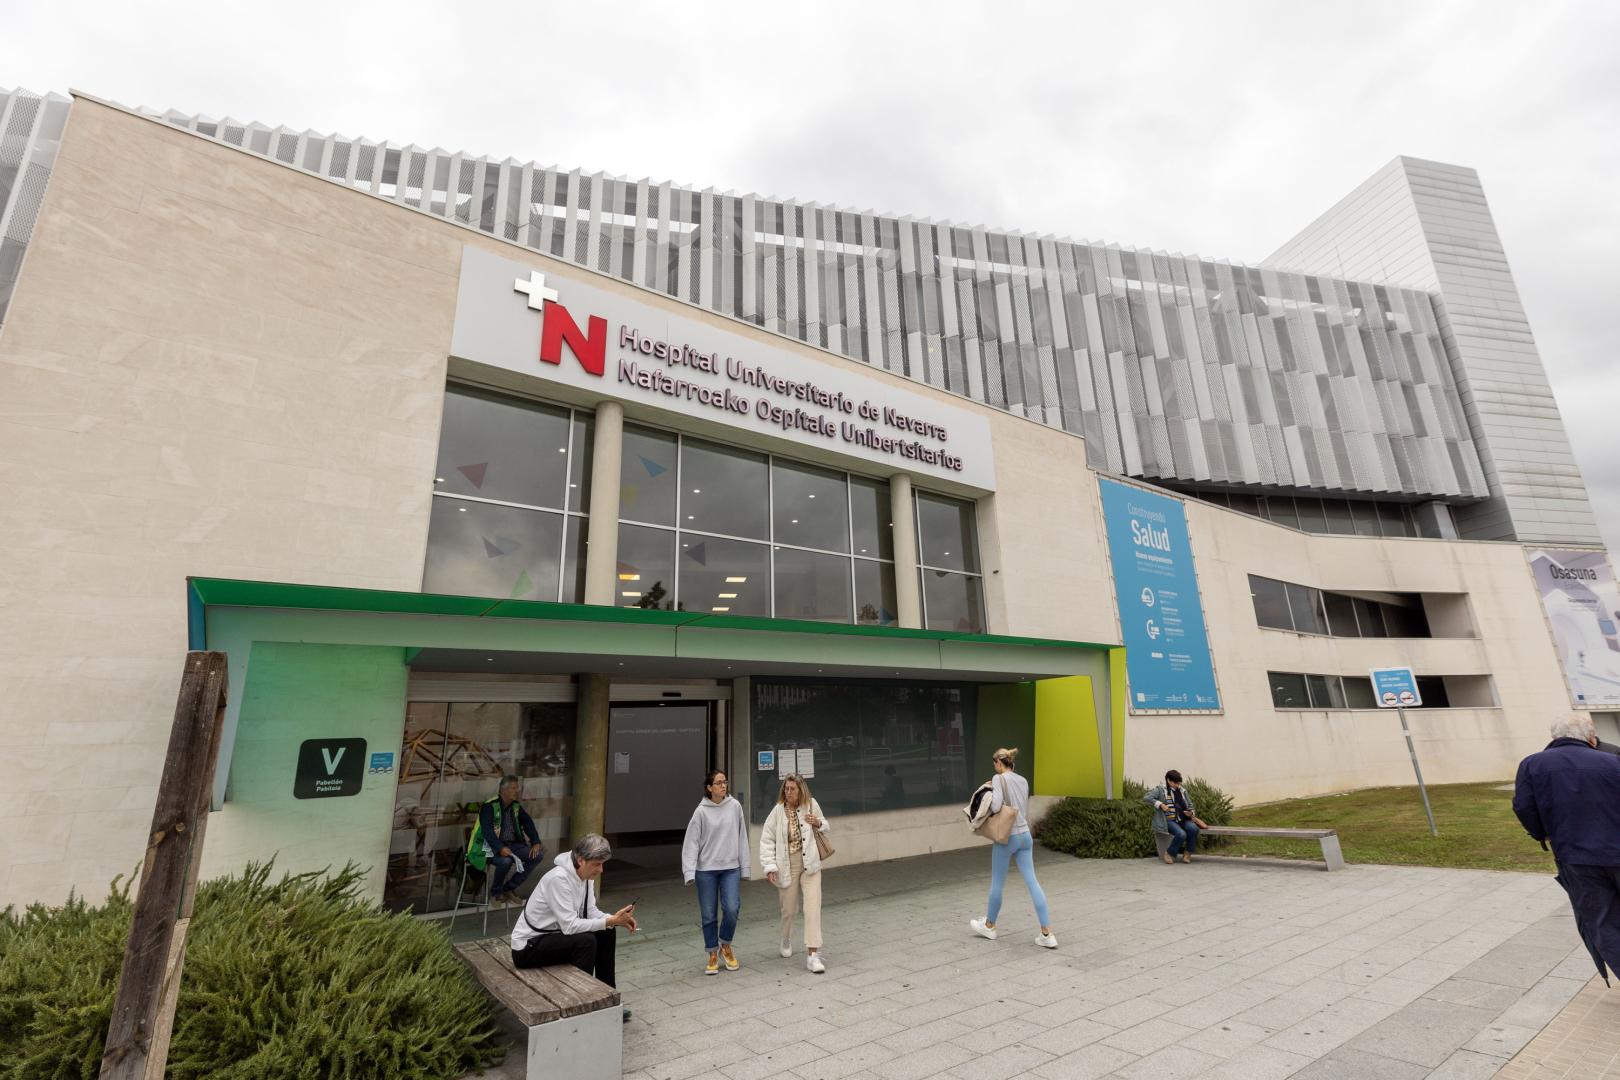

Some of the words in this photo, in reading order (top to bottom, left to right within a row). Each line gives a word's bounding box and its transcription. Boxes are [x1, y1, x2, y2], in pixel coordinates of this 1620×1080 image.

[540, 300, 608, 376] N
[620, 324, 719, 374] Hospital
[726, 357, 855, 413] Universitario
[858, 400, 880, 421] de
[884, 405, 948, 442] Navarra
[618, 358, 749, 415] Nafarroako
[756, 398, 836, 437] Ospitale
[841, 420, 964, 472] Unibertsitarioa
[1131, 519, 1171, 552] Salud
[1549, 564, 1598, 580] Osasuna
[321, 747, 346, 775] V
